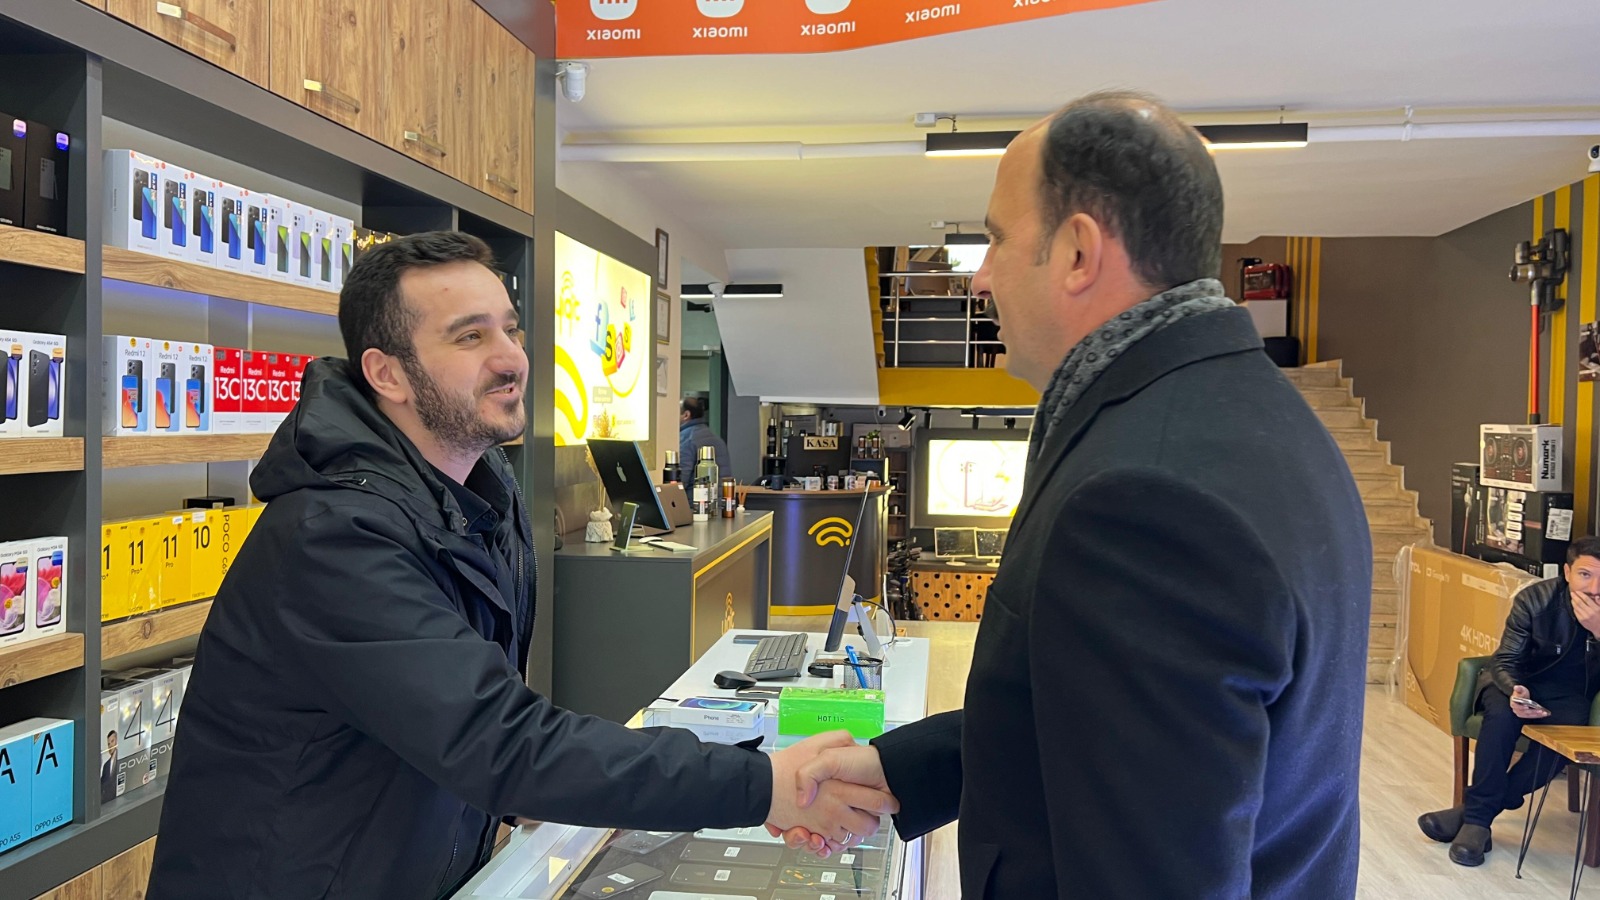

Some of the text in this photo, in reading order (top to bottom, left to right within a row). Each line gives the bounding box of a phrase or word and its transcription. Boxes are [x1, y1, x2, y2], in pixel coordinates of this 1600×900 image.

[905, 3, 961, 23] xiaomi
[586, 28, 641, 41] xiaomi
[692, 26, 748, 39] xiaomi
[800, 21, 856, 36] xiaomi
[125, 349, 139, 357] Redmi
[220, 365, 235, 374] Redmi
[248, 368, 262, 376] Redmi
[215, 377, 240, 400] 13C
[243, 378, 266, 401] 13C
[268, 380, 290, 402] 13C
[291, 381, 301, 402] 13
[806, 439, 836, 448] KASA
[1541, 440, 1549, 479] Numark
[163, 534, 177, 559] 11
[193, 525, 211, 549] 10
[128, 539, 144, 566] 11
[1460, 624, 1472, 643] 4K
[1472, 629, 1491, 652] HDR
[155, 689, 176, 733] 4
[124, 700, 145, 745] 4
[35, 732, 58, 775] A
[150, 741, 174, 758] POV
[118, 754, 149, 772] POVA
[34, 813, 63, 832] OPPO A55
[0, 832, 21, 848] PO A55
